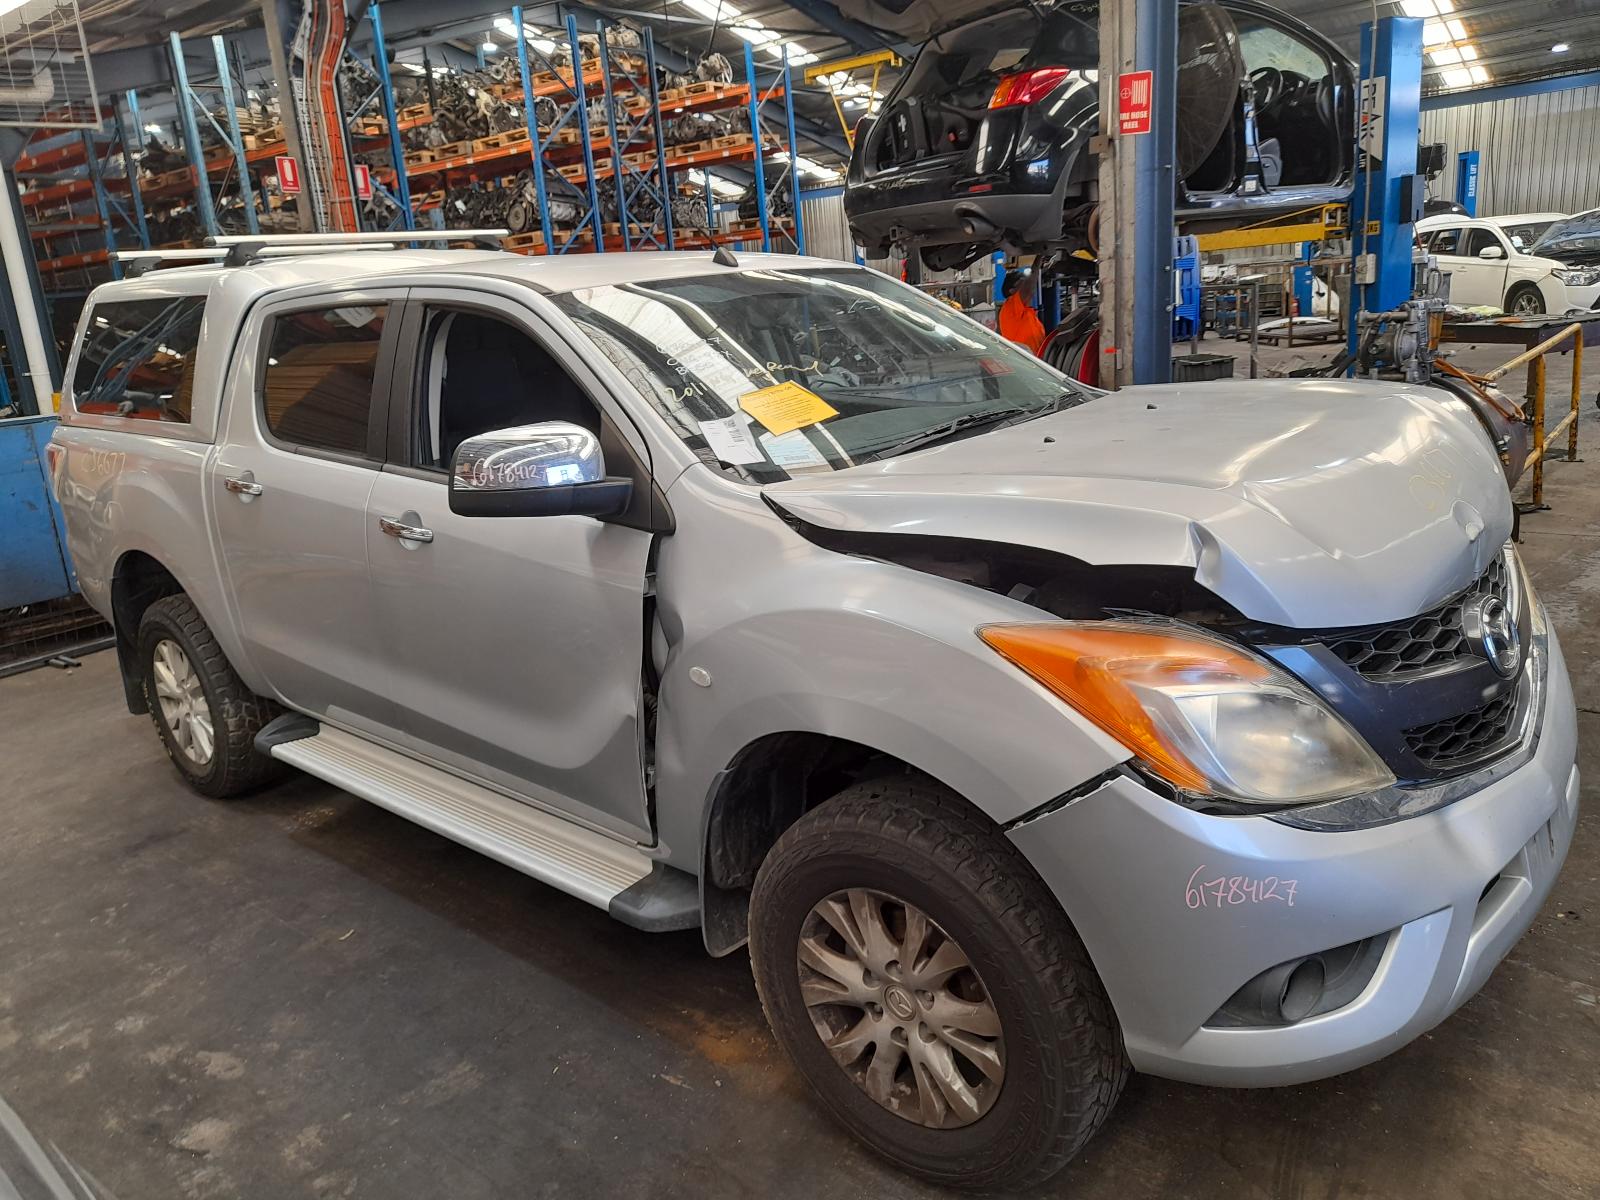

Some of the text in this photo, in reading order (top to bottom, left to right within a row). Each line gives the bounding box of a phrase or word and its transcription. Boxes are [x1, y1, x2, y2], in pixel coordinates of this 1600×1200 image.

[1122, 120, 1139, 129] REEL
[1130, 110, 1148, 119] HOSE
[1468, 164, 1478, 197] CLASSIC LIFT
[664, 381, 708, 403] 2011
[1185, 864, 1298, 909] 61784127
